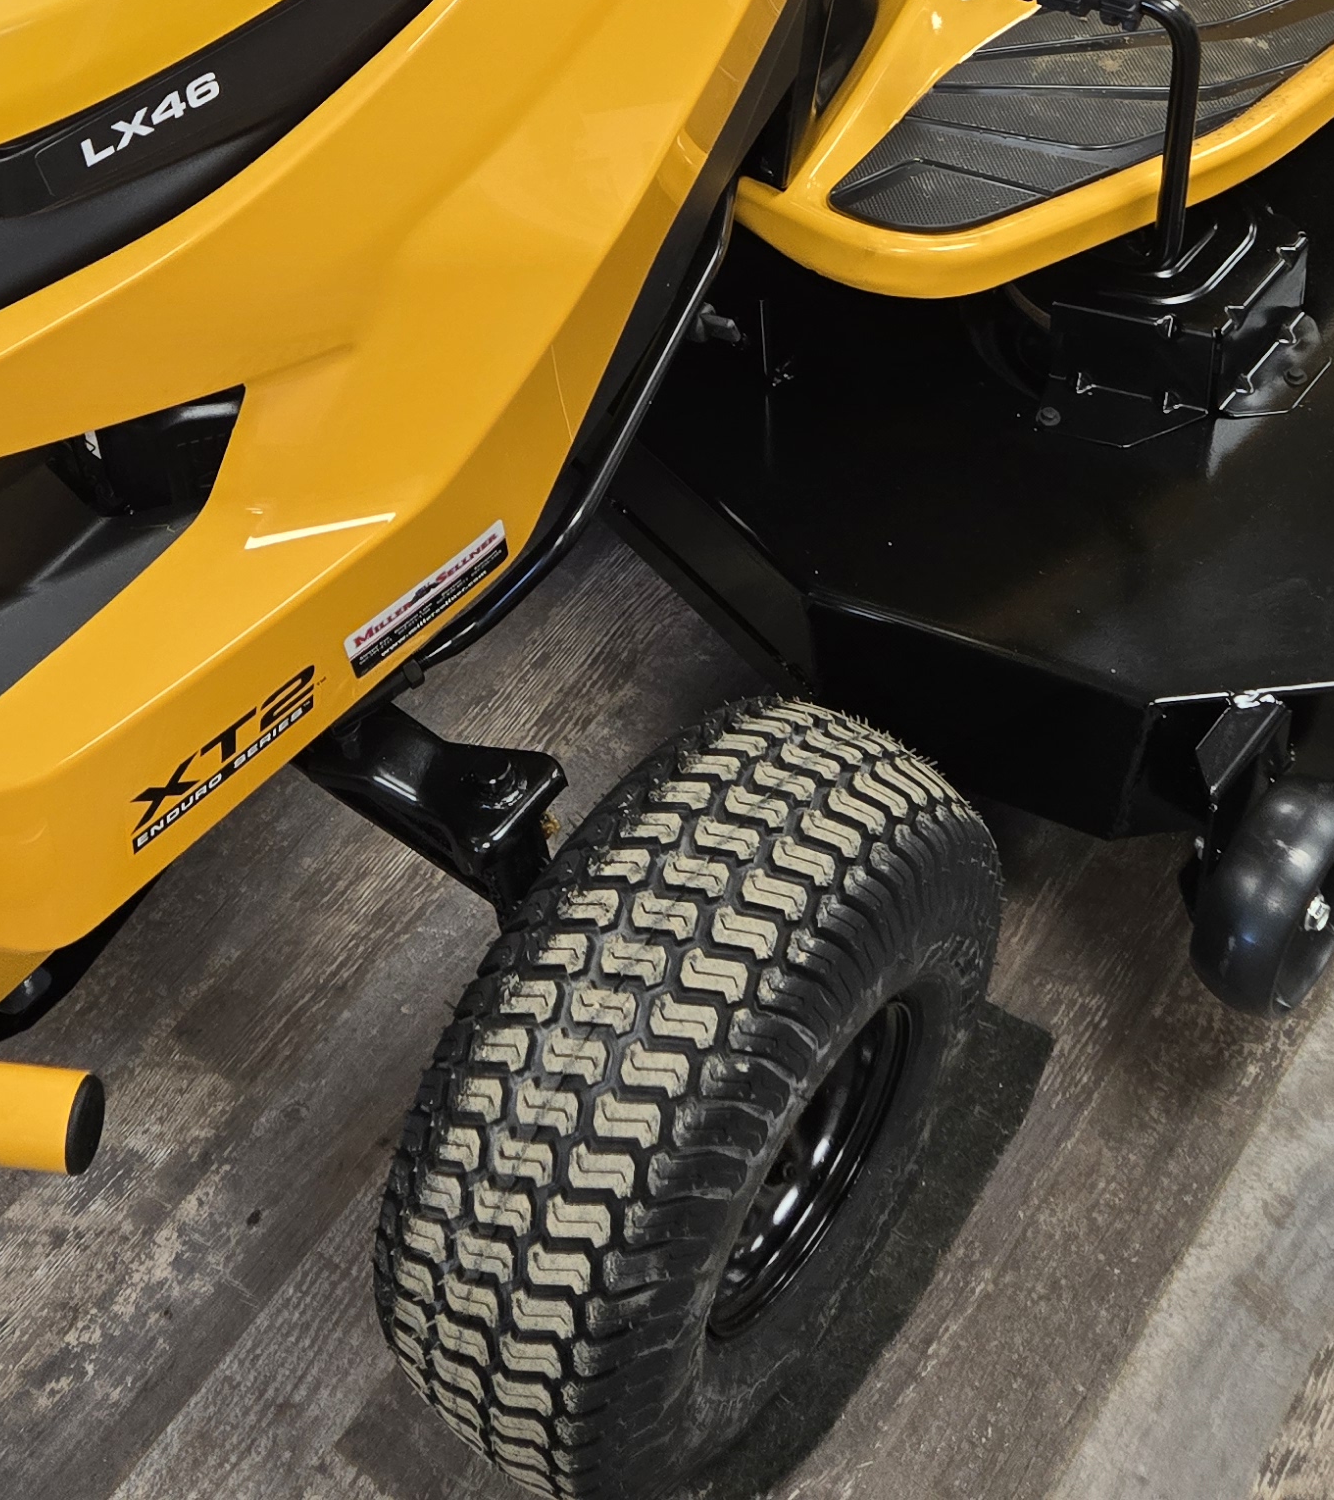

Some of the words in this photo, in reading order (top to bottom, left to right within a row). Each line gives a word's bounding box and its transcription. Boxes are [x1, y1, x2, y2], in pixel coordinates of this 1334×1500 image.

[79, 70, 222, 169] LX46
[353, 599, 414, 649] MILLER
[434, 532, 499, 584] SELLNER
[135, 771, 224, 850] ENDURO
[232, 706, 306, 770] SERIES
